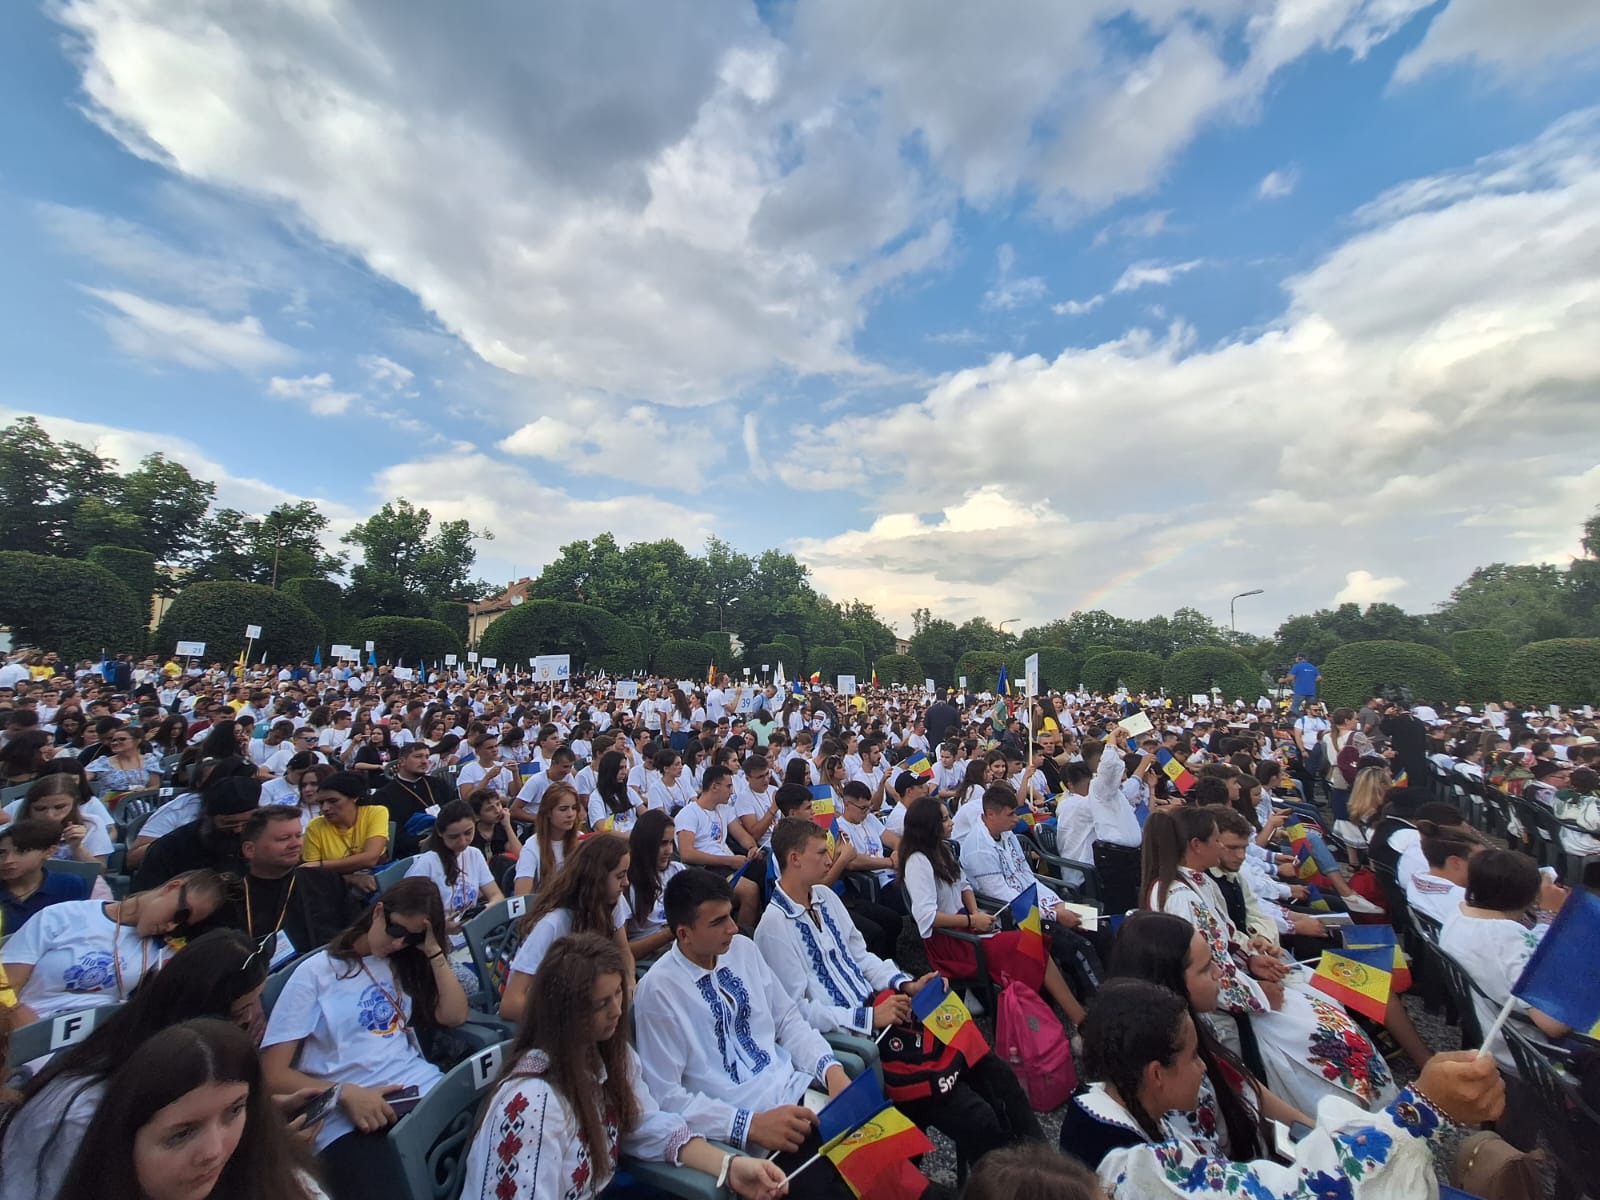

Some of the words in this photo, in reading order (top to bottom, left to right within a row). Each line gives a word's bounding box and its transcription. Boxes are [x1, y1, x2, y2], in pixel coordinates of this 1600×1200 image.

[557, 664, 568, 676] 64
[741, 697, 751, 708] 39
[512, 900, 520, 914] F
[63, 1016, 82, 1041] F
[480, 1052, 493, 1079] F
